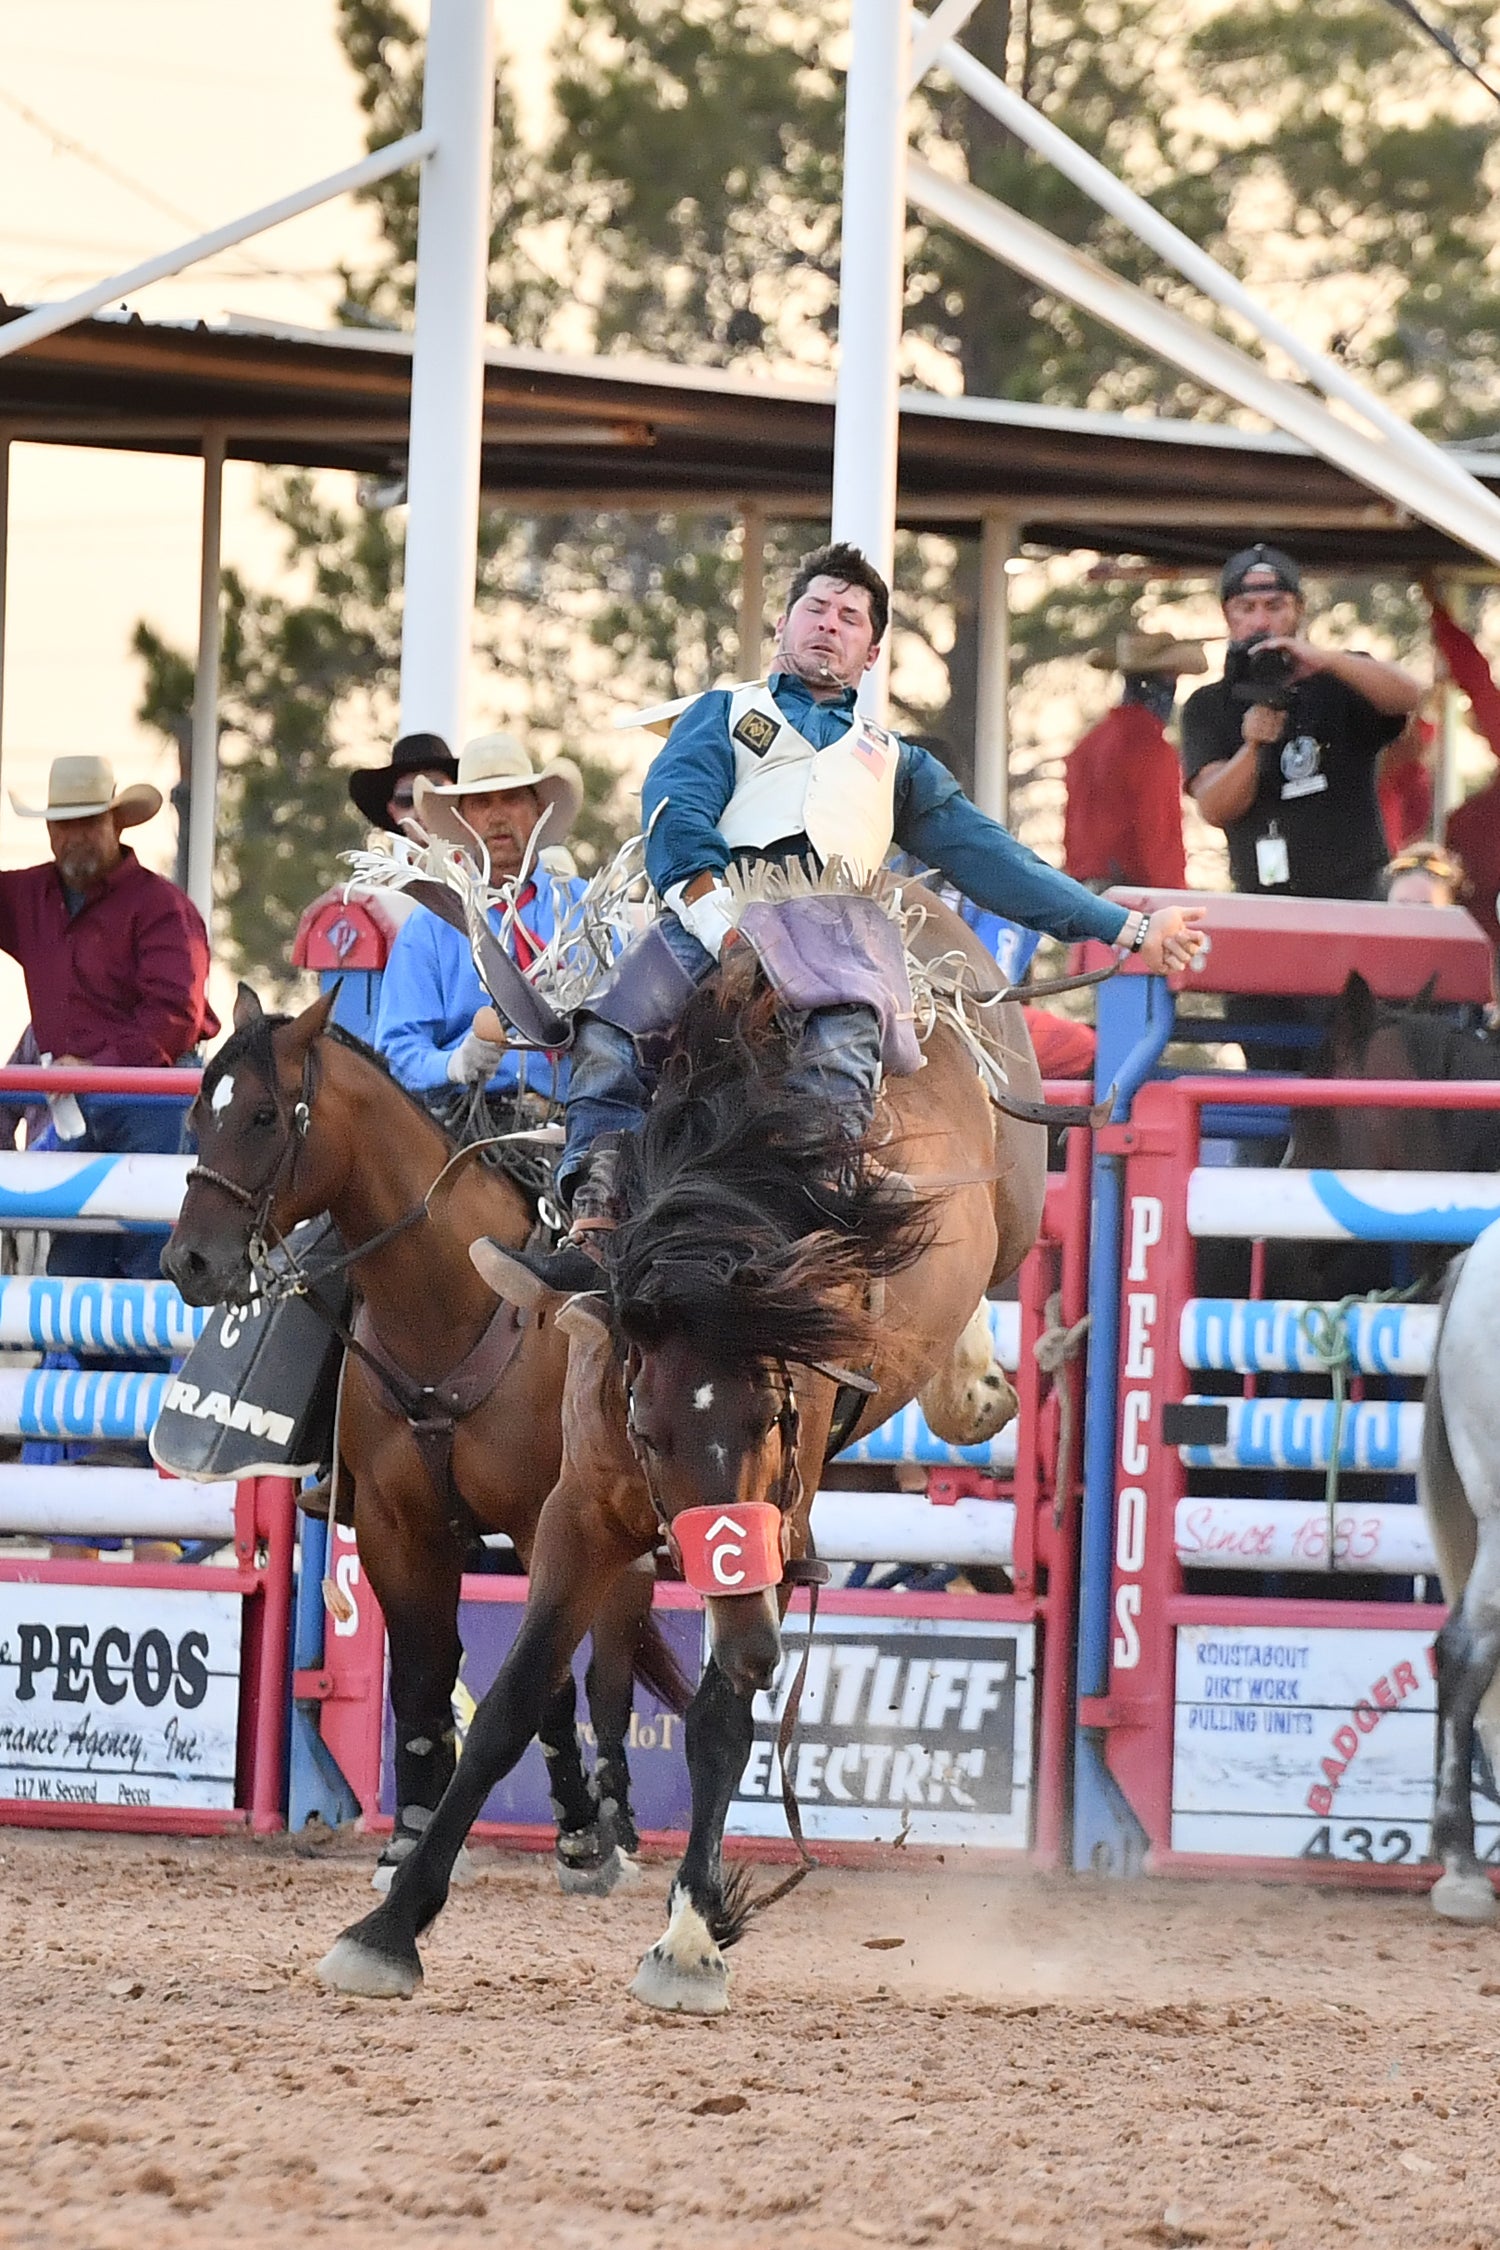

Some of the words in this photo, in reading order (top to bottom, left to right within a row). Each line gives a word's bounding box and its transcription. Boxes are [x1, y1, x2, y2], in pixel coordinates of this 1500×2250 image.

[165, 1380, 295, 1446] RAM
[1114, 1196, 1162, 1669] PECOS
[15, 1623, 209, 1709] PECOS
[1197, 1643, 1309, 1668] ROUSTABOUT
[1205, 1676, 1242, 1699] DIRT
[1249, 1678, 1298, 1701] WORK
[1189, 1708, 1257, 1733] PULLING
[1263, 1711, 1313, 1735] UNITS
[1307, 1661, 1420, 1817] BADGER
[739, 1741, 985, 1807] ELECTRIC
